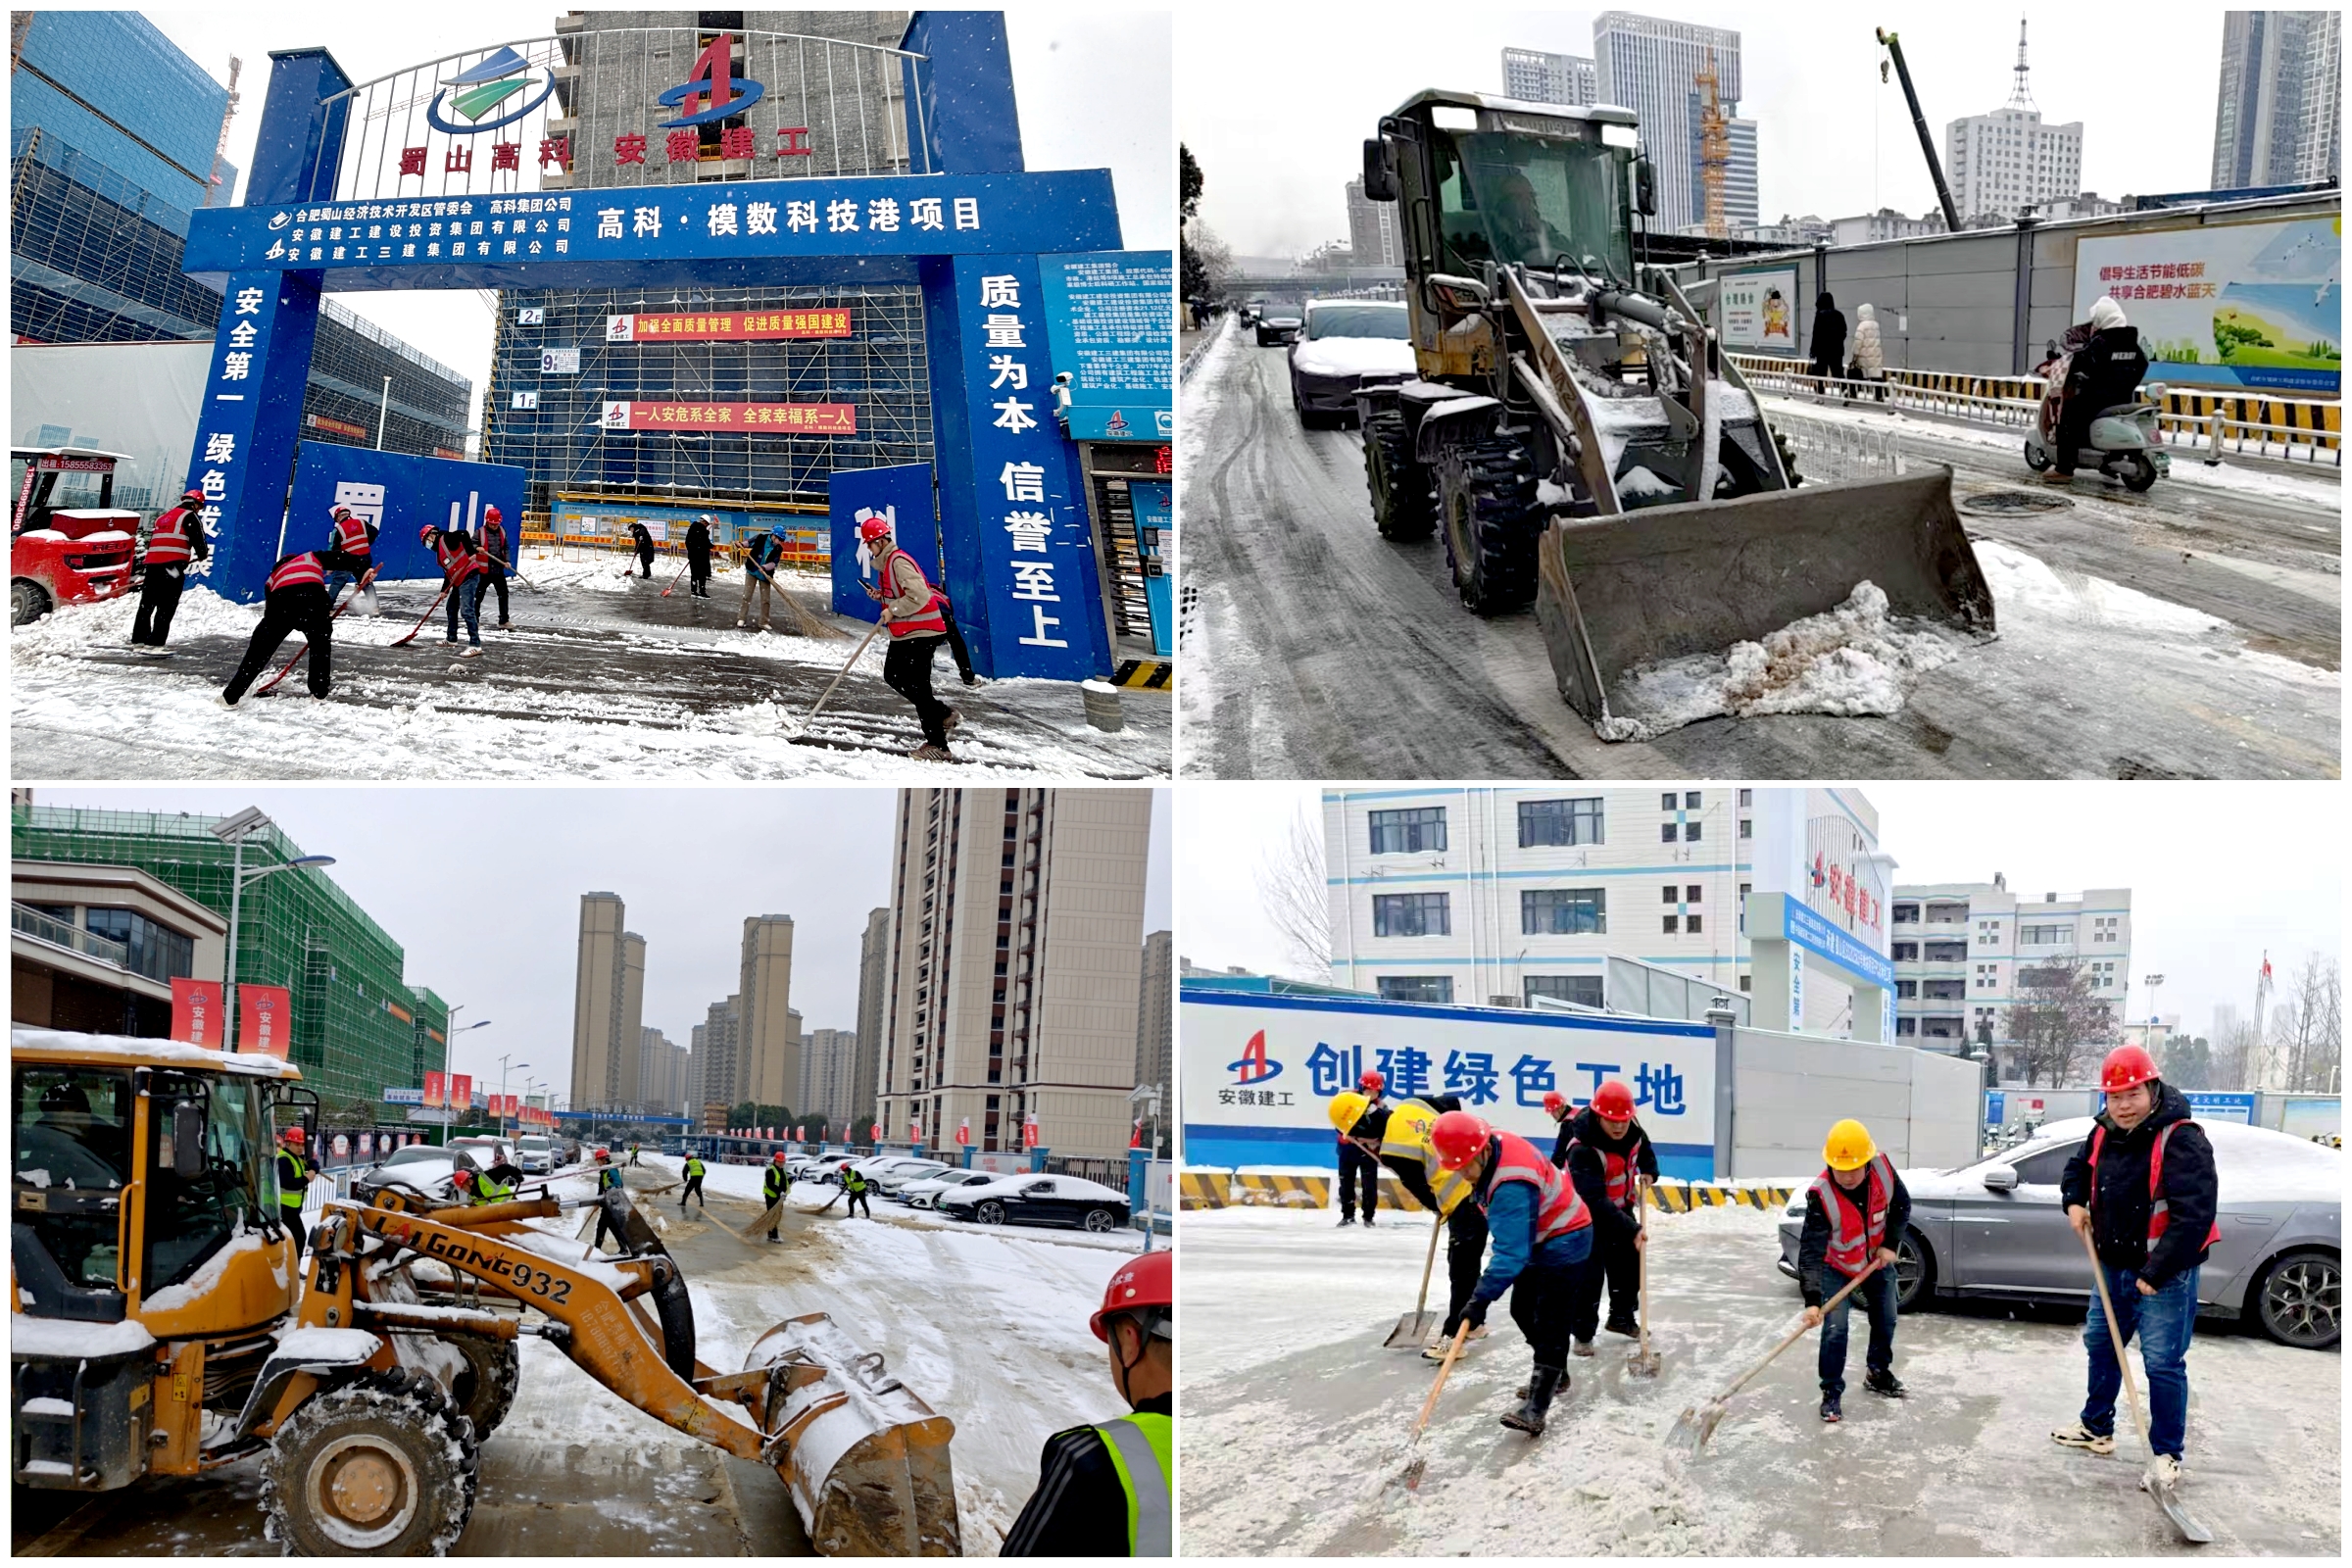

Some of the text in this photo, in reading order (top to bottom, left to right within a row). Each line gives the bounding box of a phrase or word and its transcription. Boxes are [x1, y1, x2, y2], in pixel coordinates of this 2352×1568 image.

[399, 136, 571, 176] 蜀山高科
[613, 125, 812, 167] 安徽建工
[295, 197, 572, 223] 合肥蜀山经济技术开发区管委会 高科集团公司
[291, 218, 570, 243] 安徽建工建设投资集团有限公司
[287, 238, 569, 262] 安徽建工三建集团有限公司
[2099, 262, 2206, 281] 倡导生活节能低碳
[2108, 282, 2217, 300] 共享合肥碧水蓝天
[524, 310, 541, 323] 2F
[638, 311, 847, 334] 加强全面质量管理 促进质量强国建设
[216, 287, 264, 402] 安全第一
[519, 393, 535, 408] 1F
[634, 407, 852, 425] 一人安危系全家 全家幸福系一人
[979, 273, 1069, 649] 质量为本 信誉至上
[190, 1005, 205, 1046] 安徽建
[1305, 1041, 1687, 1116] 创建绿色工地
[1218, 1089, 1297, 1108] 安徽建工
[2186, 1095, 2242, 1104] 建文明工地
